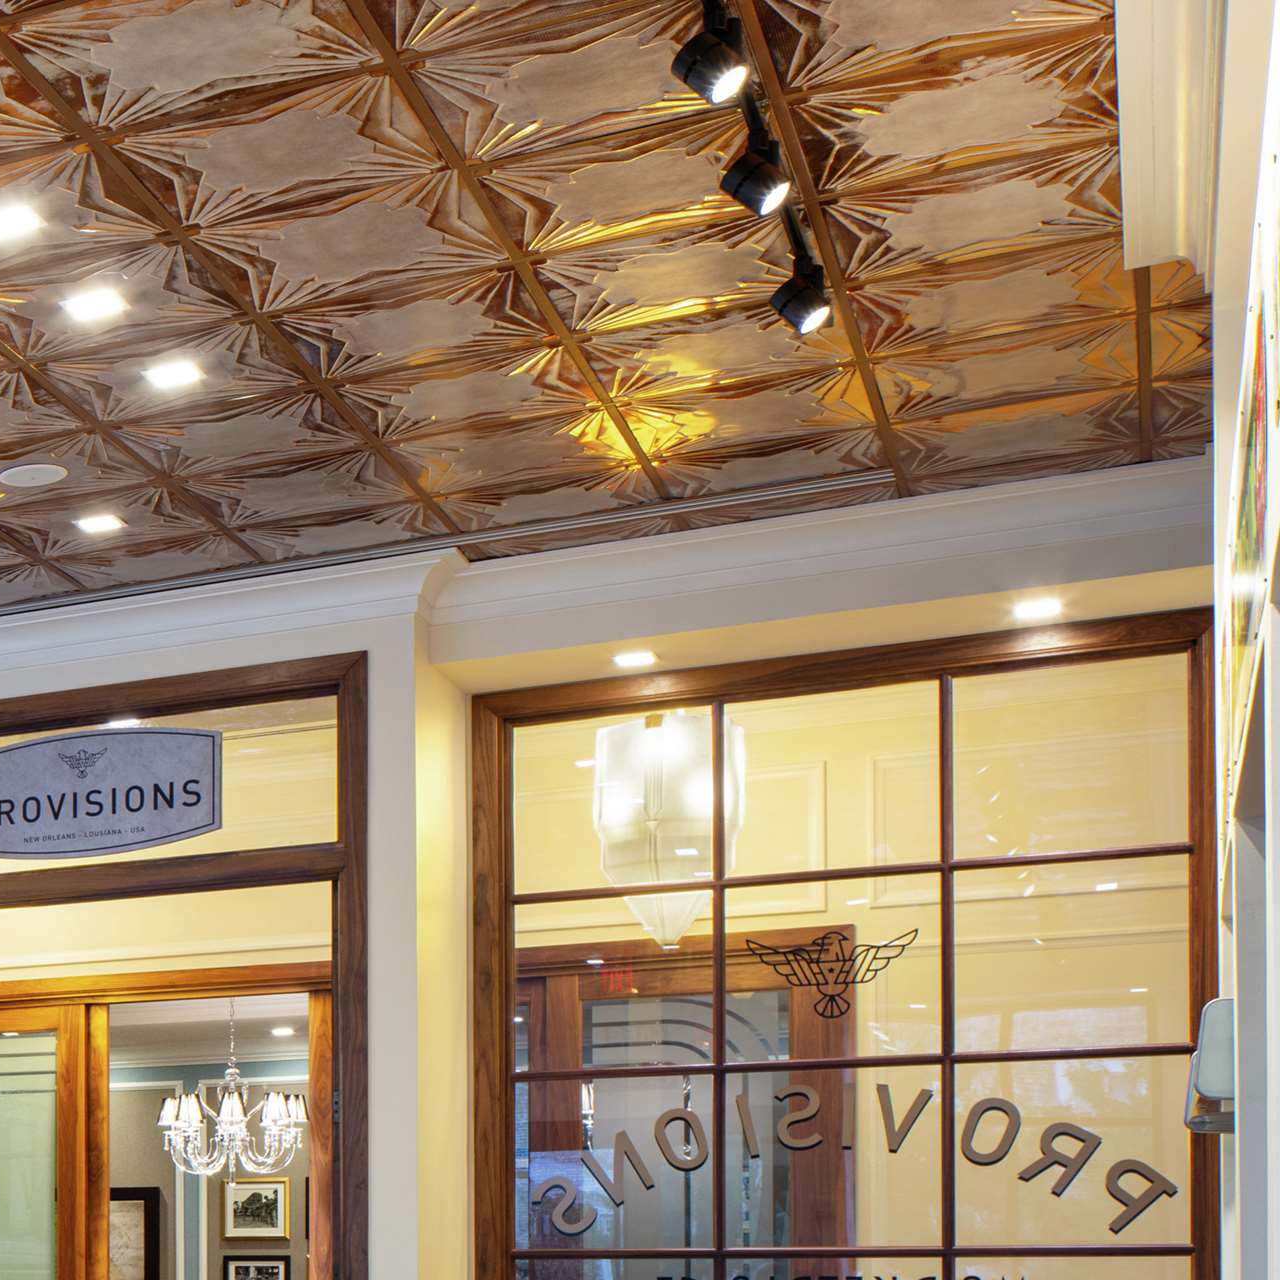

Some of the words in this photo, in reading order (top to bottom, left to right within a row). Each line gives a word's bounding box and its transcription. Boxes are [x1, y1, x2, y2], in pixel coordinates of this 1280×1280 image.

[23, 836, 40, 844] NEW
[42, 832, 77, 842] ORLEANS
[130, 826, 145, 834] USA
